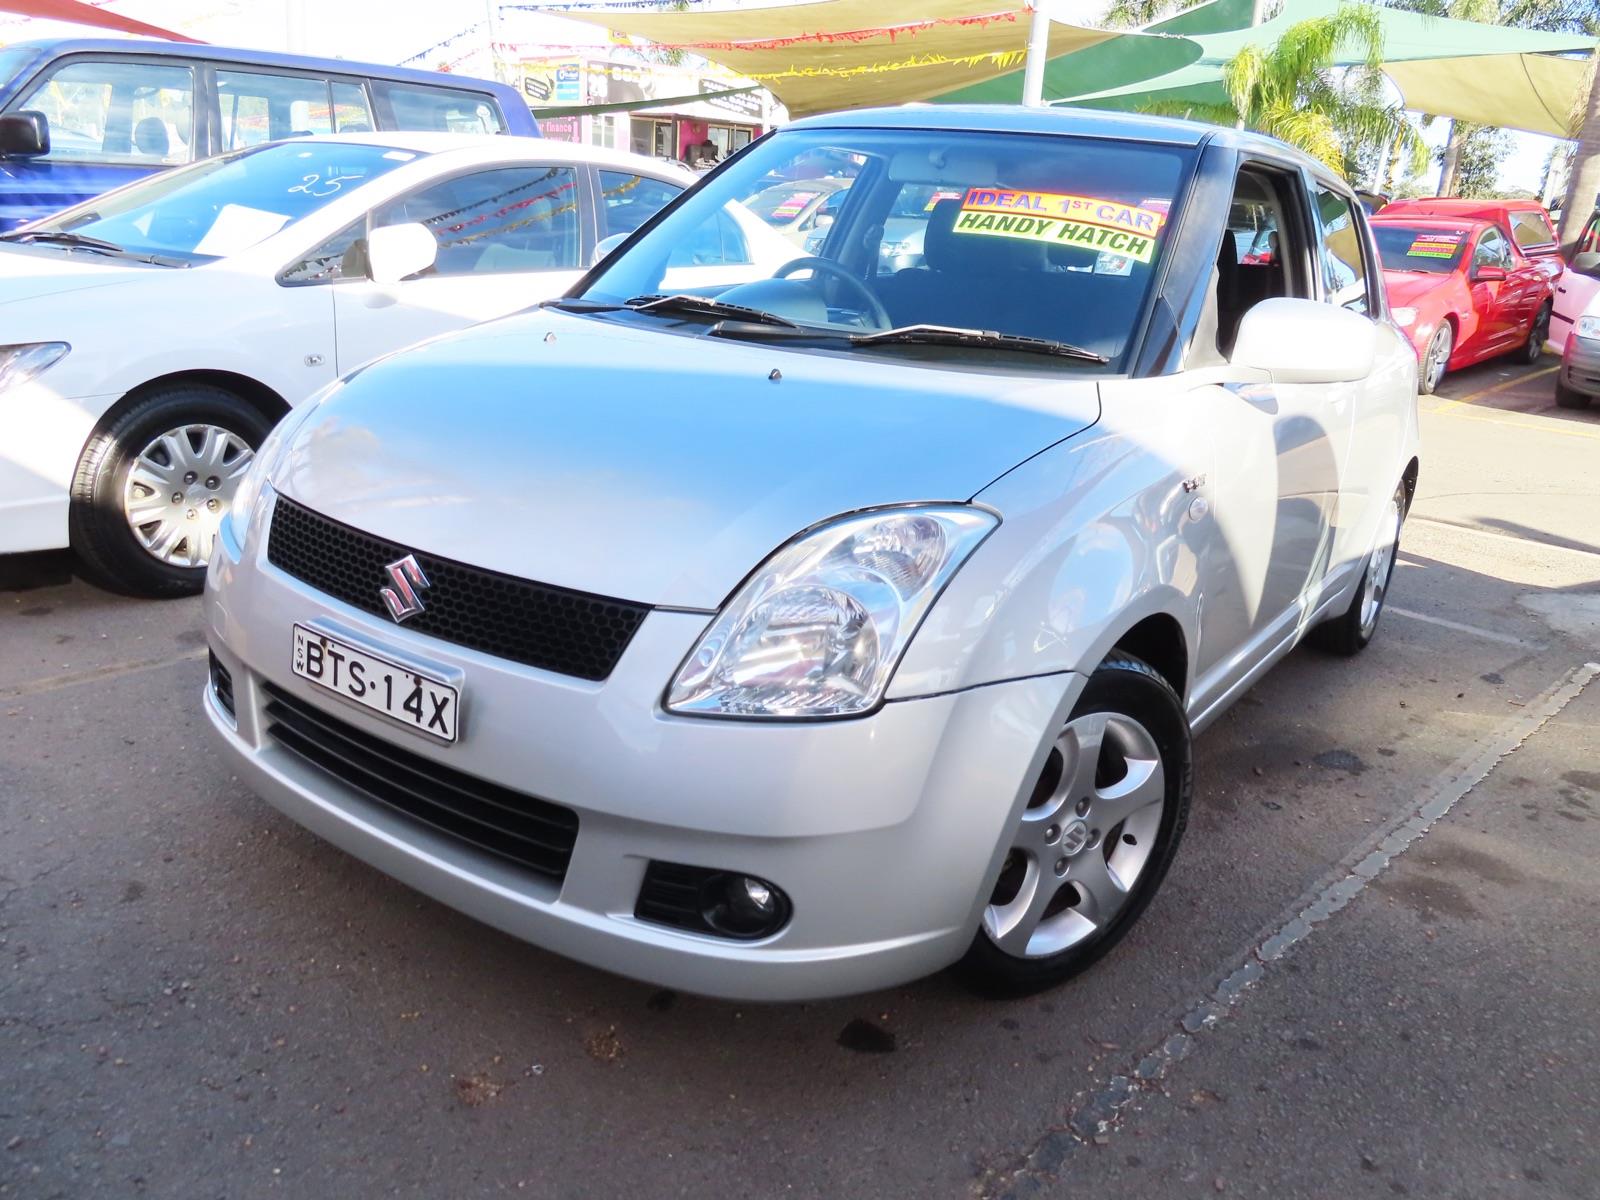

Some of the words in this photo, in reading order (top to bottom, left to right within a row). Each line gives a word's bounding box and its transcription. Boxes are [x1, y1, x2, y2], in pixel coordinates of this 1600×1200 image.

[547, 121, 572, 132] finance
[287, 174, 364, 197] 25
[967, 191, 1047, 212] IDEAL
[1095, 204, 1155, 231] CAR
[958, 213, 1054, 235] HANDY
[1057, 222, 1150, 255] HATCH
